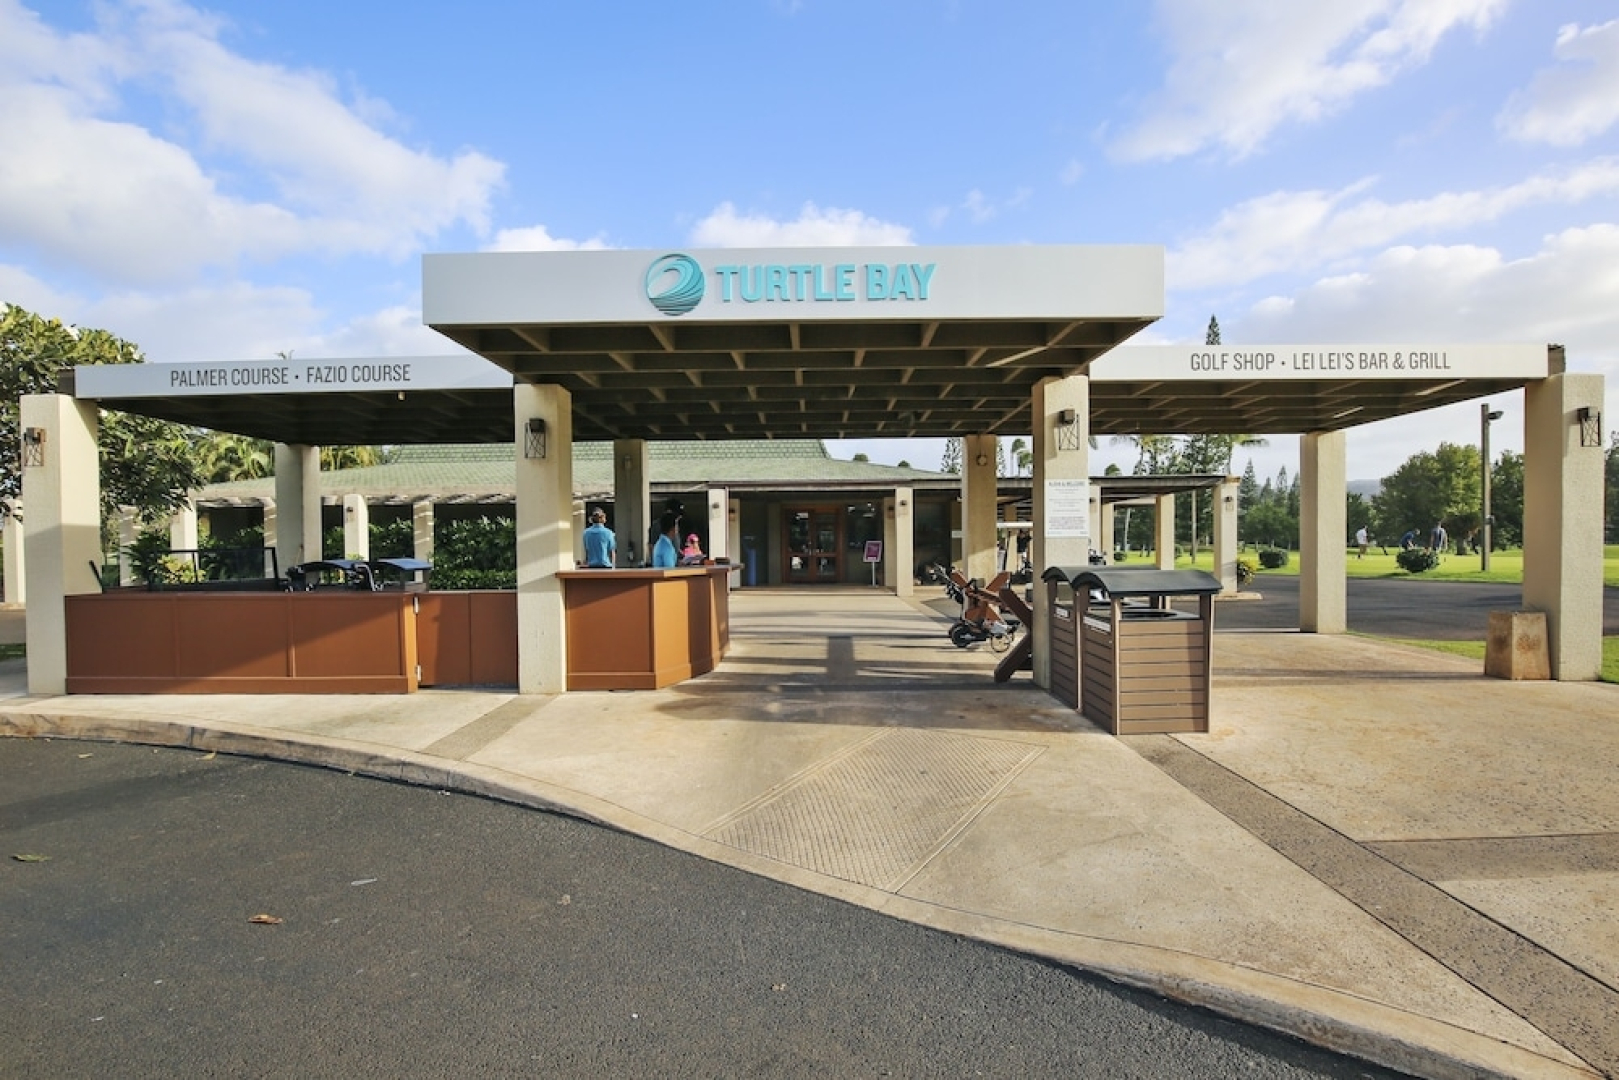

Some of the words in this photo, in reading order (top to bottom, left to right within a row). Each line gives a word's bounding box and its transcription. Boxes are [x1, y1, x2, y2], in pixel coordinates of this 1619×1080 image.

[715, 263, 856, 303] TURTLE
[865, 262, 937, 301] BAY
[1190, 352, 1229, 371] GOLF
[1233, 352, 1275, 371] SHOP
[1293, 352, 1315, 370] LEI
[1319, 352, 1355, 370] LEI'S
[1359, 352, 1389, 370] BAR
[1393, 352, 1406, 370] &
[1409, 352, 1451, 370] GRILL
[170, 368, 228, 388] PALMER
[231, 367, 290, 386] COURSE
[306, 365, 347, 384] FAZIO
[352, 364, 411, 383] COURSE
